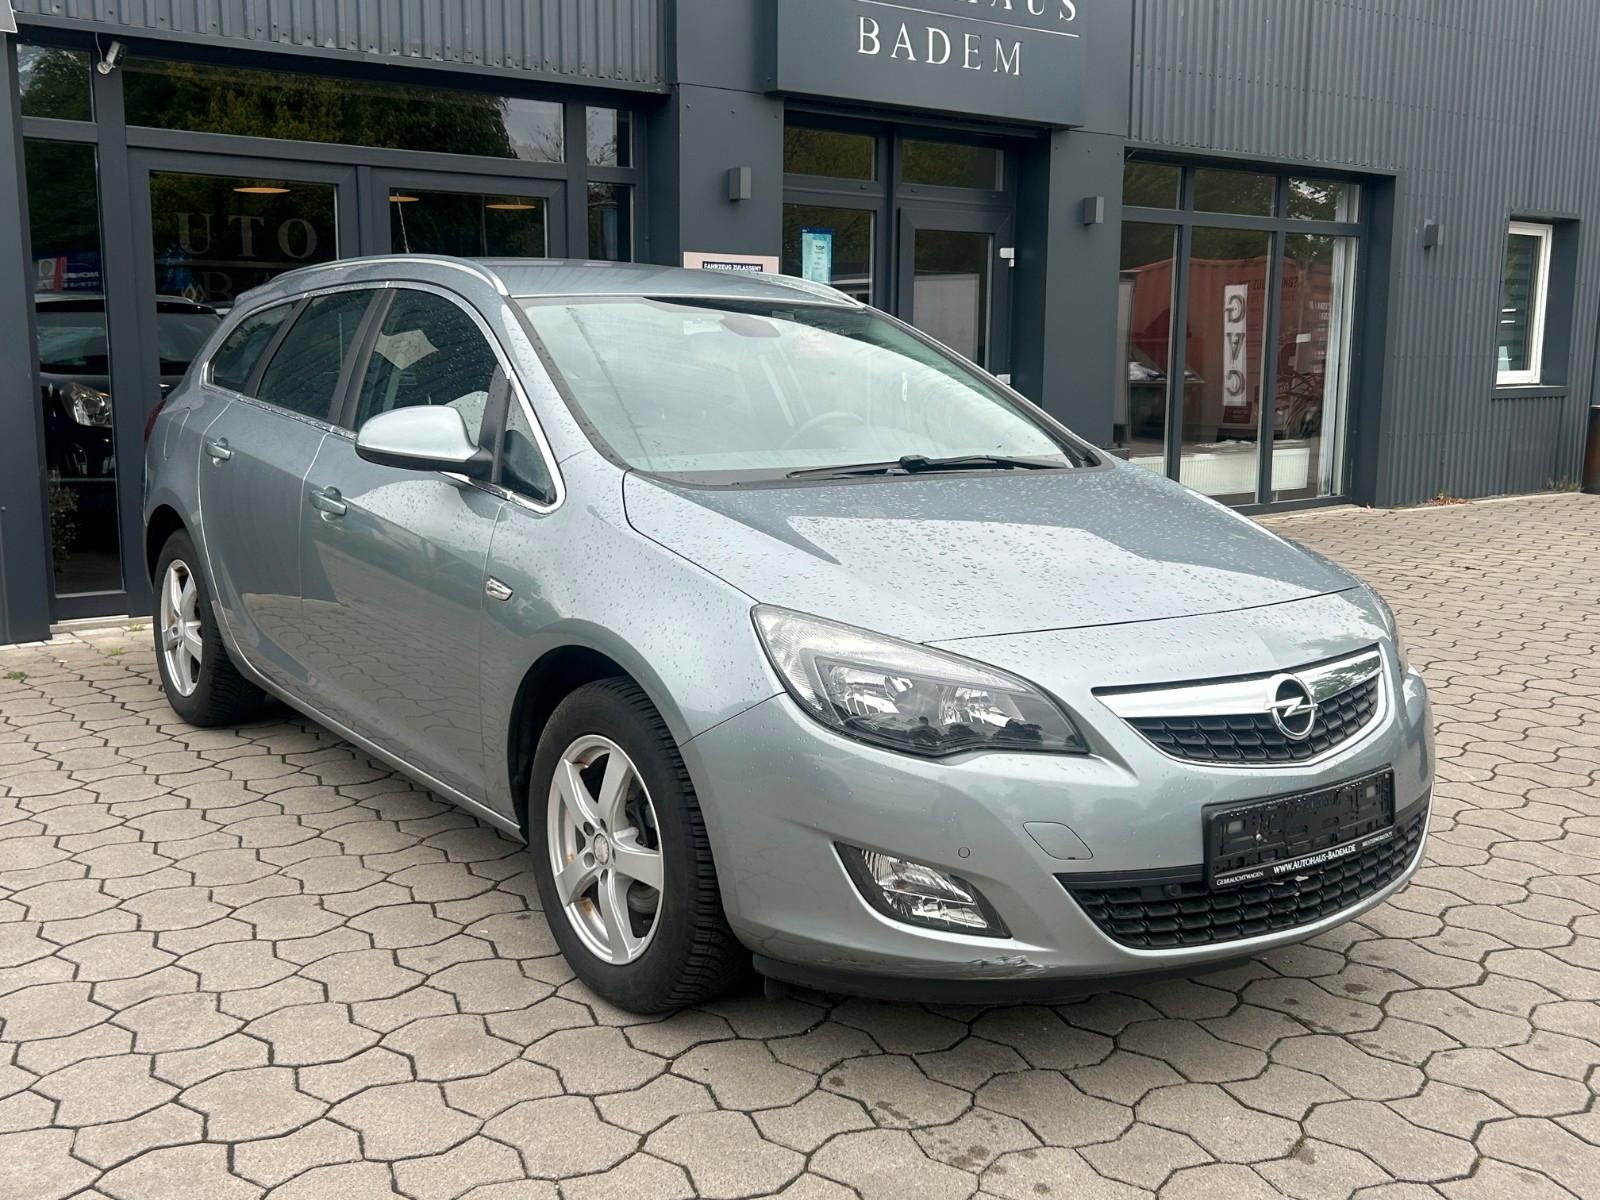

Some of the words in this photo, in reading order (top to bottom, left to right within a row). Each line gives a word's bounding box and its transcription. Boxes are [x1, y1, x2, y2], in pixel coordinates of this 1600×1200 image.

[857, 16, 1023, 76] BADEM
[175, 212, 318, 260] UTO
[703, 262, 732, 270] FAHRZEUG
[1216, 870, 1265, 887] GEBRAUCHTWAGEN
[1273, 843, 1357, 875] WWW.AUTOHAUS-BADEM.DE
